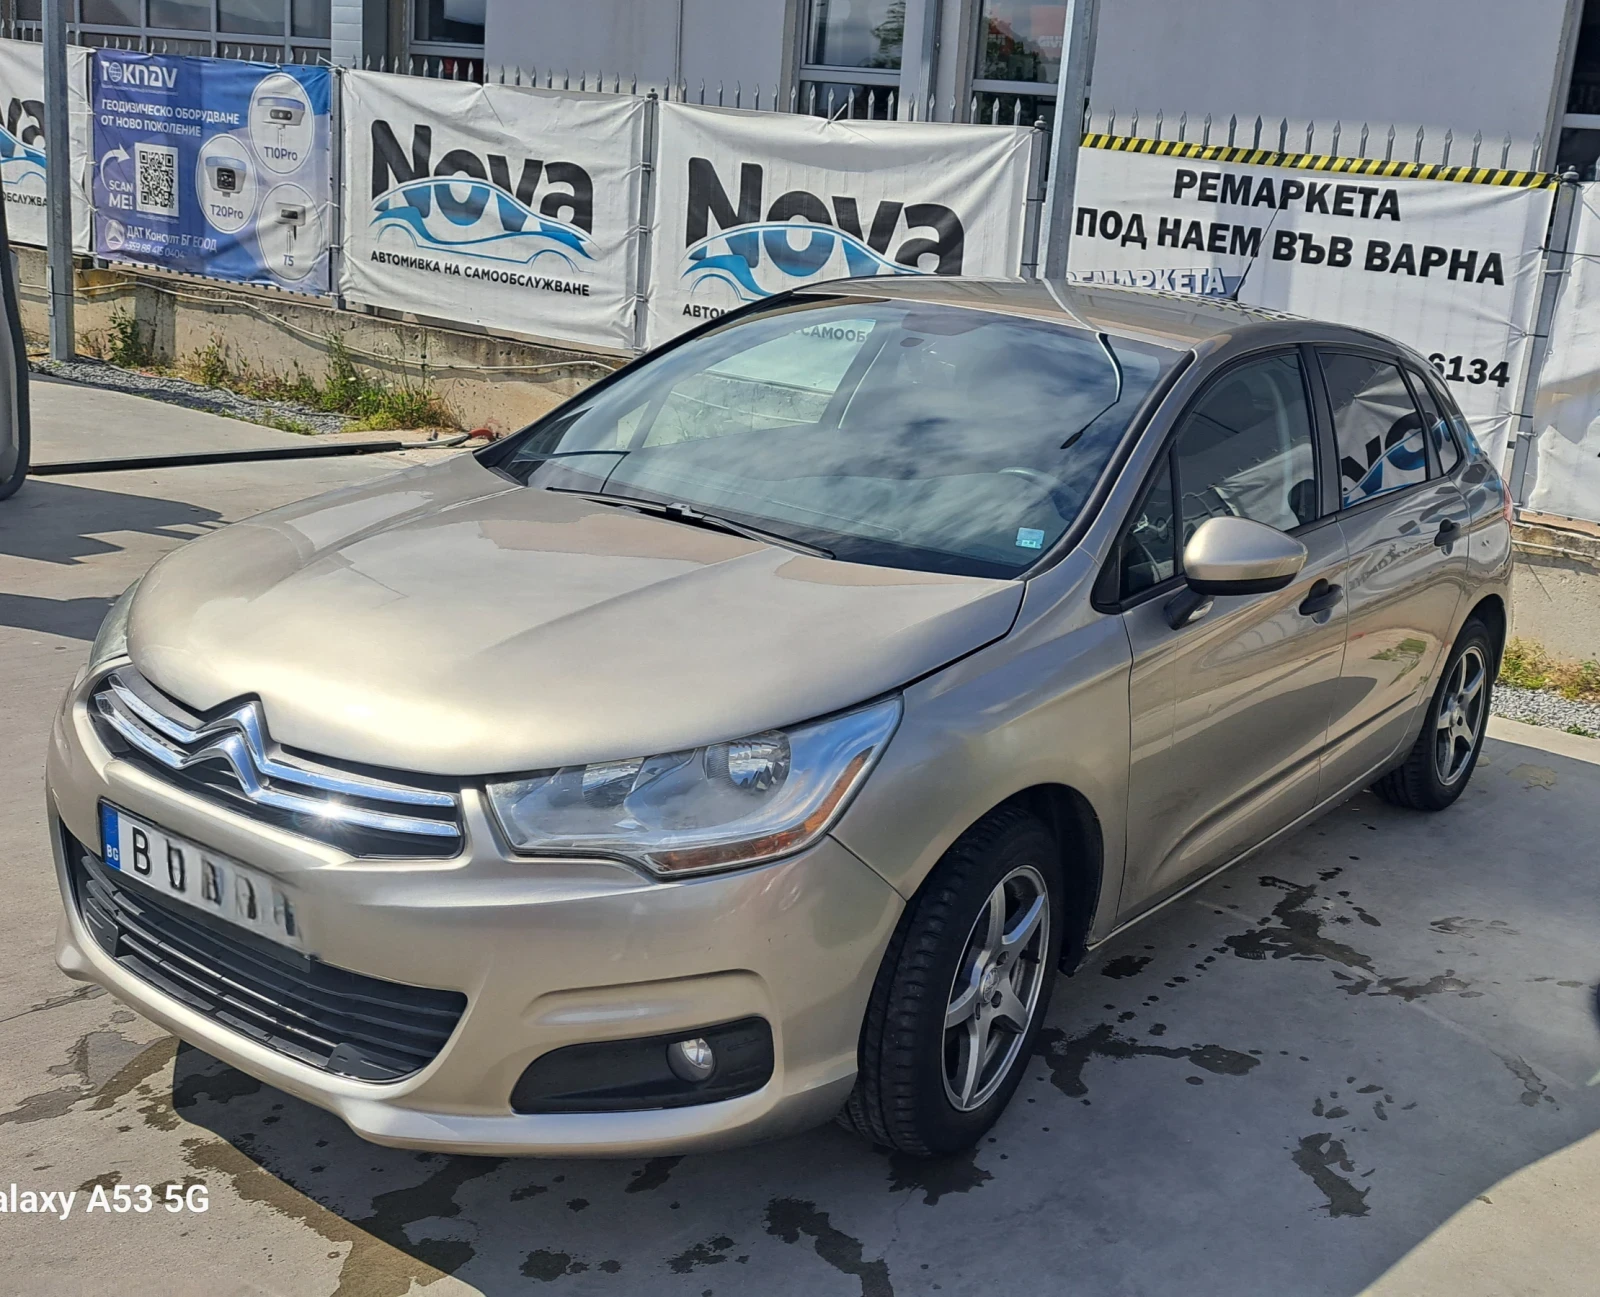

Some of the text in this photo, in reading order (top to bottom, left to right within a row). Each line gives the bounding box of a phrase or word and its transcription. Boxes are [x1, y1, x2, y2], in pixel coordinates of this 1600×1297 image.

[102, 99, 240, 125] ГЕОДИЗИЧЕСКО ОБОРУДВАНЕ
[101, 115, 202, 137] ОТ НОВО ПОКОЛЕНИЕ
[264, 146, 298, 161] T10Pro
[108, 180, 133, 192] SCAN
[371, 119, 593, 235] Nova
[108, 193, 133, 210] ME!
[1173, 168, 1401, 221] РЕМАРКЕТА
[210, 204, 244, 219] T20Pro
[686, 156, 965, 277] Nova
[127, 225, 144, 240] ДАТ
[1075, 206, 1505, 286] ПОД НАЕМ ВЪВ ВАРНА
[283, 254, 294, 267] T5
[370, 250, 590, 297] АВТОМИВКА НА САМООБСЛУЖВАНЕ
[106, 843, 119, 861] BG
